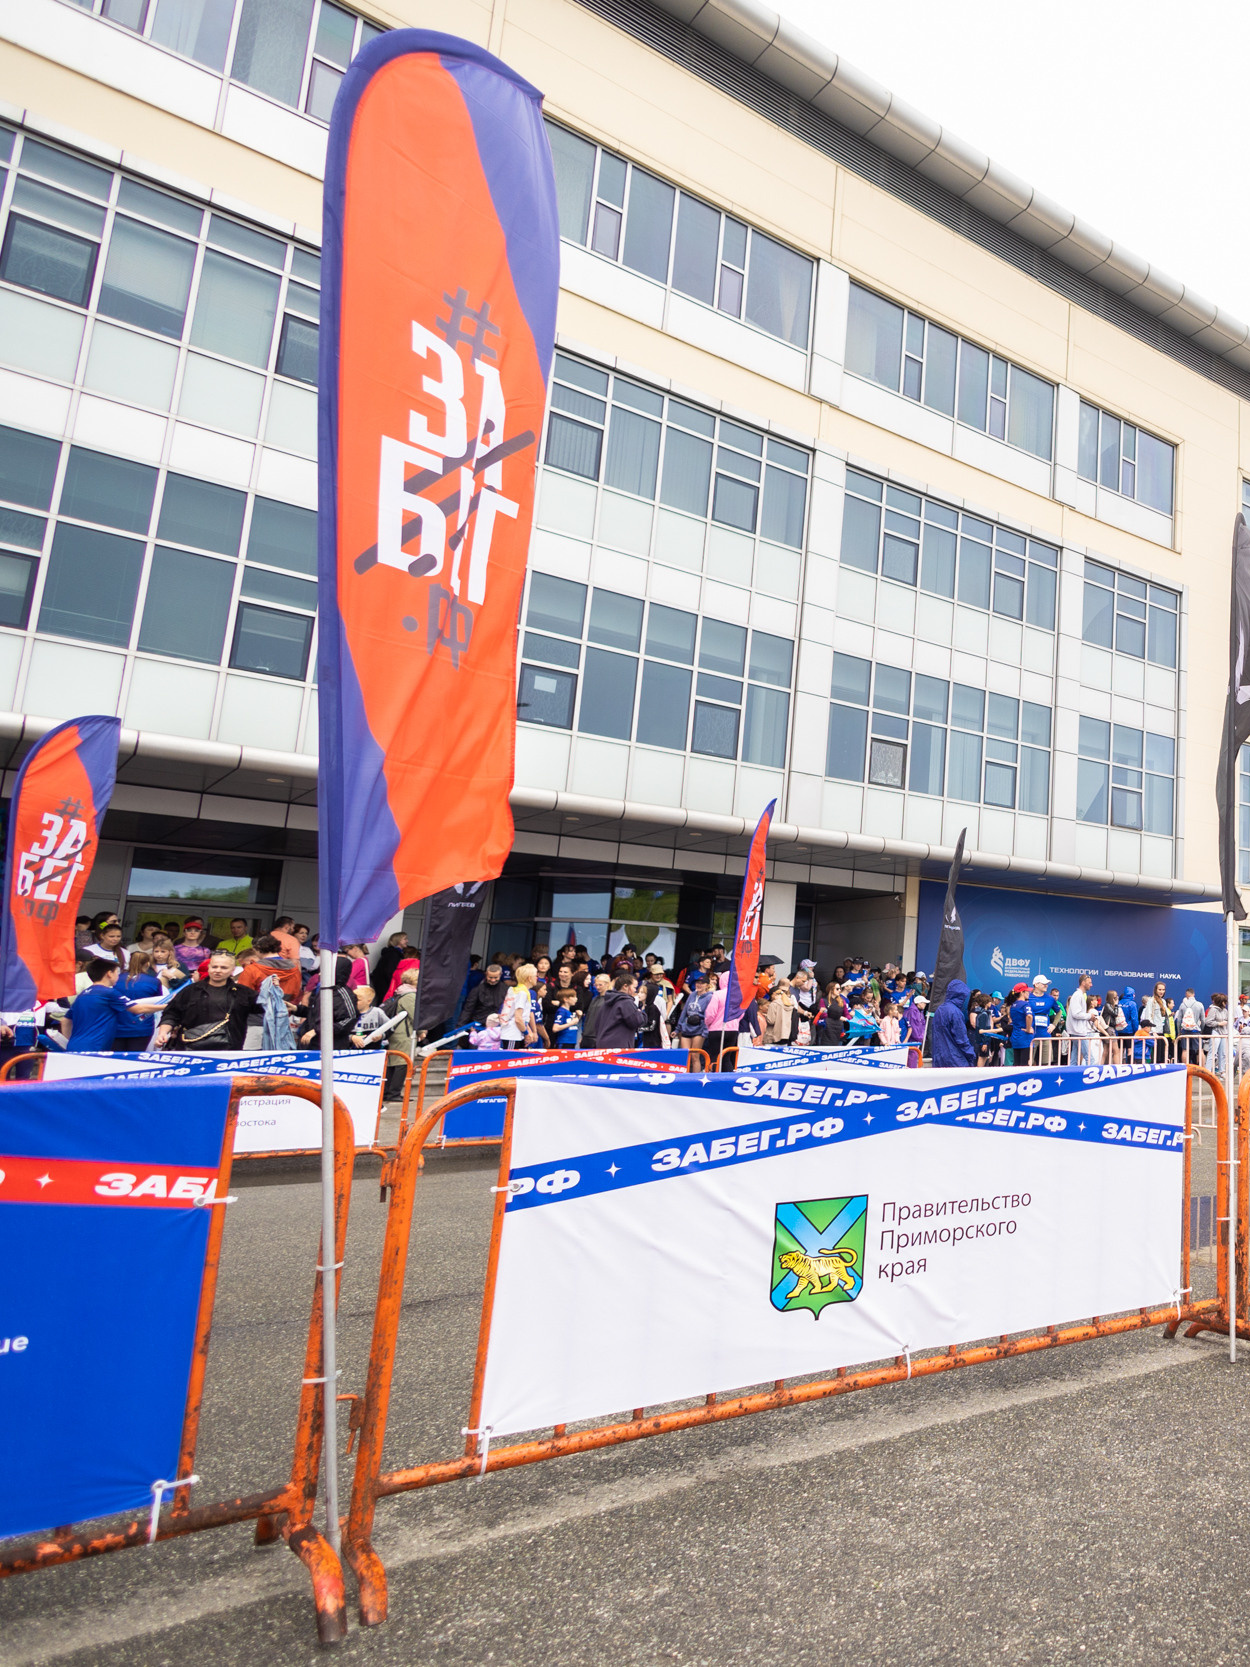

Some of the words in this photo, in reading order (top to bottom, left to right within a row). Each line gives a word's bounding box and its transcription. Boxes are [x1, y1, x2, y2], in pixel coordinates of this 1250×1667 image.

[1005, 957, 1031, 968] ДВФУ
[1049, 966, 1099, 976] ТЕХНОЛОГИИ
[1104, 970, 1155, 979] ОБРАЗОВАНИЕ
[216, 1055, 297, 1071] ЗАБЕГ.РФ
[508, 1055, 560, 1068] ЗАБЕГ.РФ
[574, 1048, 622, 1059] ЗАБЕГ.РФ
[616, 1058, 658, 1069] ЗАБЕГ.РФ
[764, 1057, 810, 1071] ЗАБЕГ.РФ
[821, 1048, 863, 1061] ЗАБЕГ.РФ
[651, 1116, 845, 1172] ЗАБЕГ.РФ
[895, 1077, 1043, 1122] ЗАБЕГ.РФ
[882, 1192, 1033, 1226] Правительство
[880, 1220, 1018, 1254] Приморского
[878, 1258, 928, 1283] края
